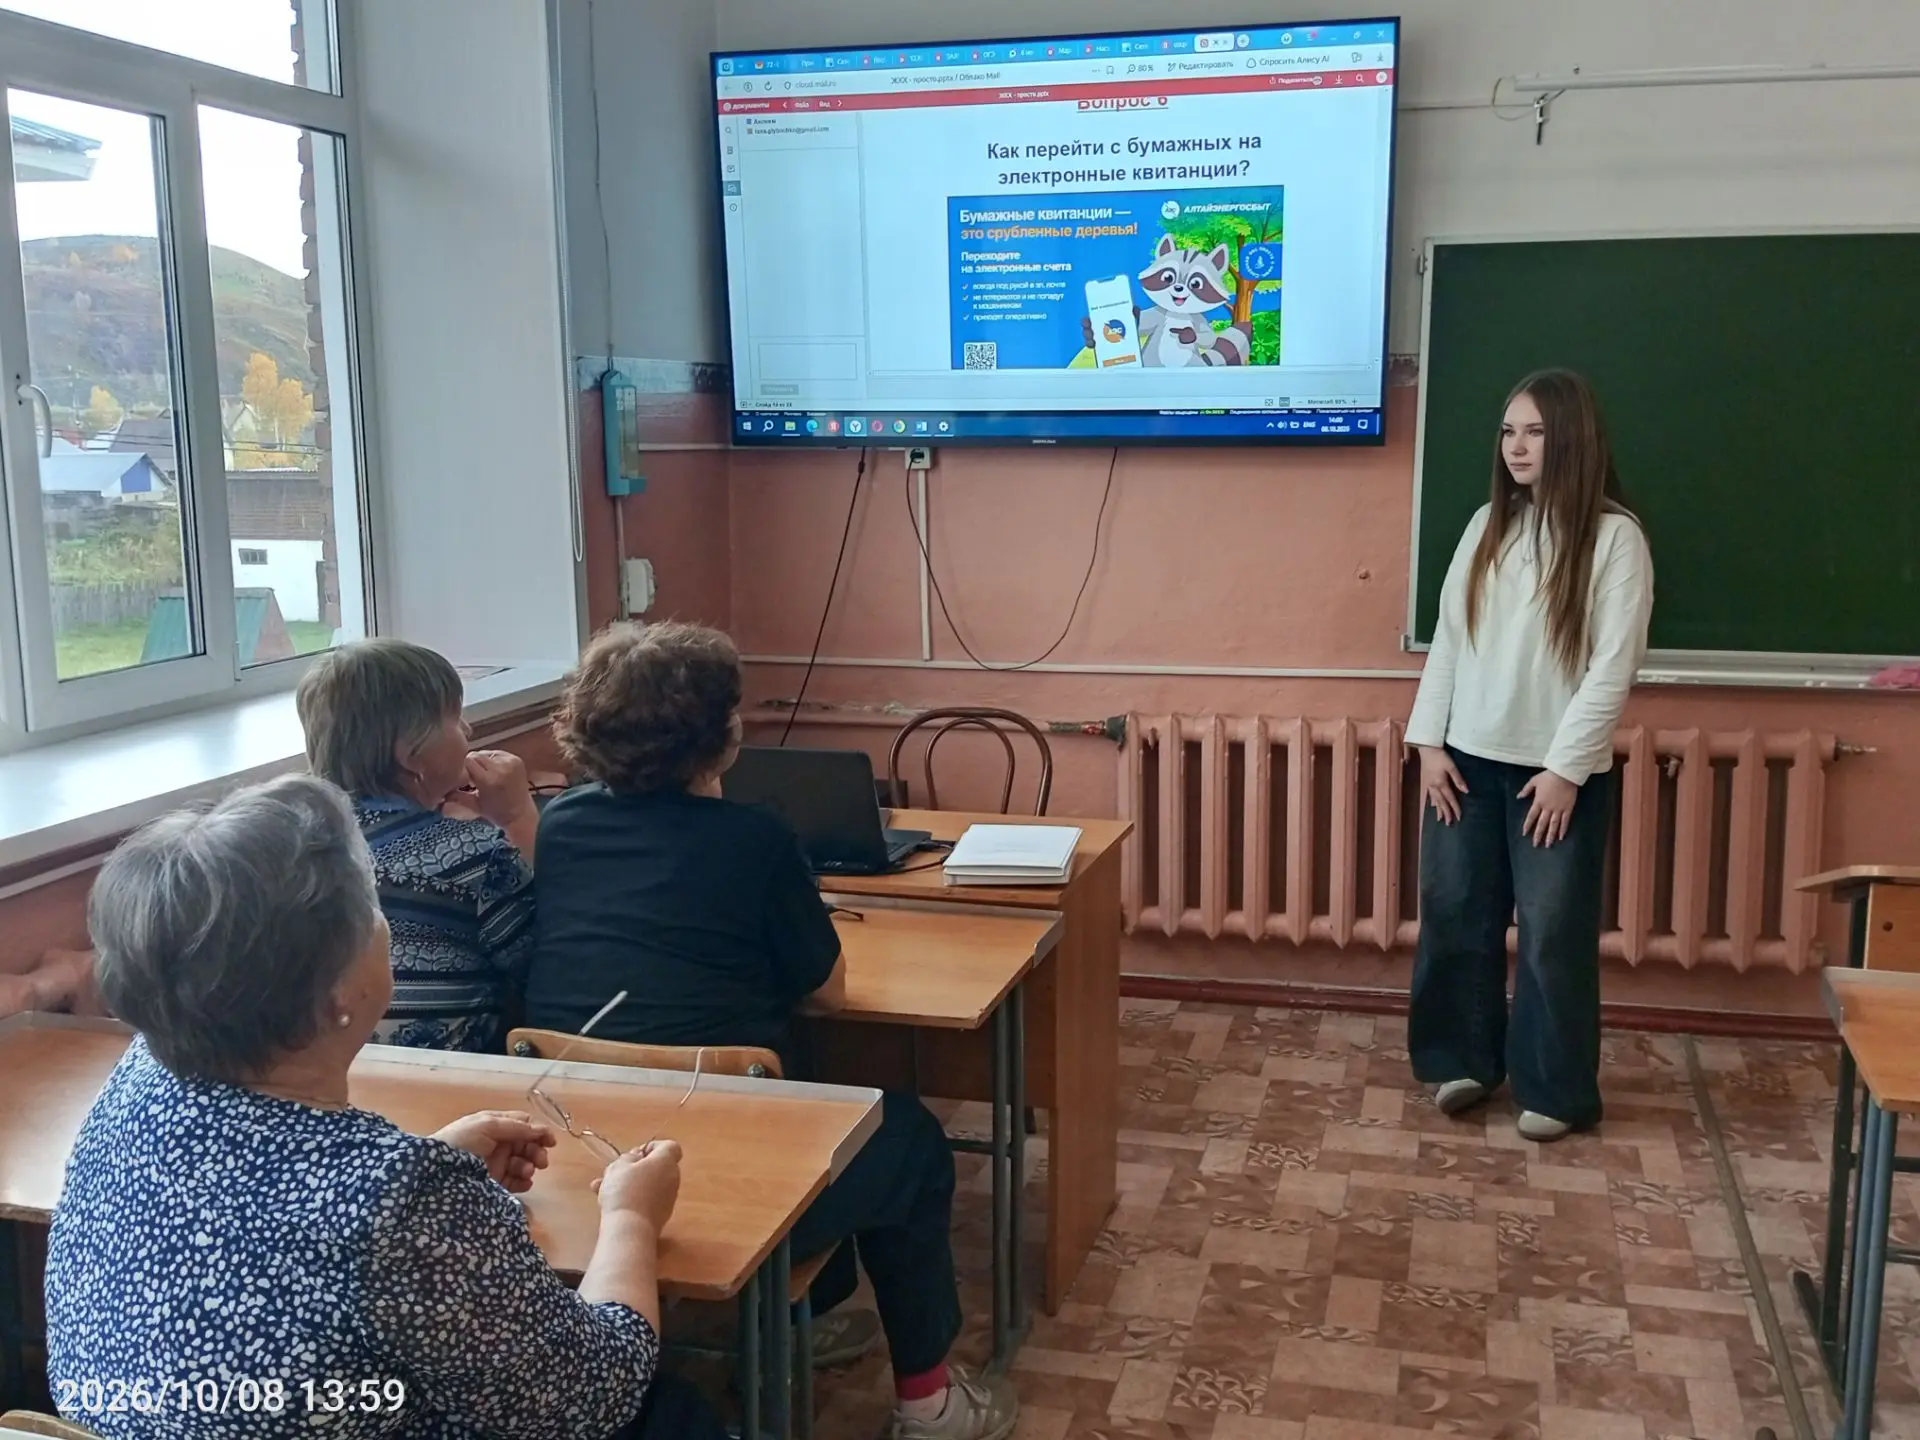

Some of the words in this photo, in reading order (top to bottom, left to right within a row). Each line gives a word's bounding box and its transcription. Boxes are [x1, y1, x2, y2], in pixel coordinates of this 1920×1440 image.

[1179, 61, 1234, 70] Редактировать
[1259, 58, 1296, 67] Спросить
[1297, 56, 1320, 65] Алису
[959, 73, 985, 82] Облако
[795, 81, 837, 89] cloud.mail.ru
[987, 143, 1019, 159] Как
[1025, 140, 1104, 161] перейти
[1110, 142, 1121, 155] с
[1127, 136, 1232, 157] бумажных
[1239, 136, 1262, 150] на
[998, 168, 1126, 187] электронные
[1132, 160, 1251, 181] квитанции?
[1183, 203, 1272, 214] АЛТАЙЭНЕРГОСБЫТ
[960, 209, 1035, 225] Бумажные
[1038, 207, 1112, 221] квитанции
[961, 229, 984, 240] это
[987, 225, 1072, 242] срубленные
[1075, 222, 1138, 239] деревья!
[961, 251, 1021, 263] Переходите
[961, 265, 973, 273] на
[975, 264, 1041, 275] электронные
[1043, 262, 1072, 272] счета
